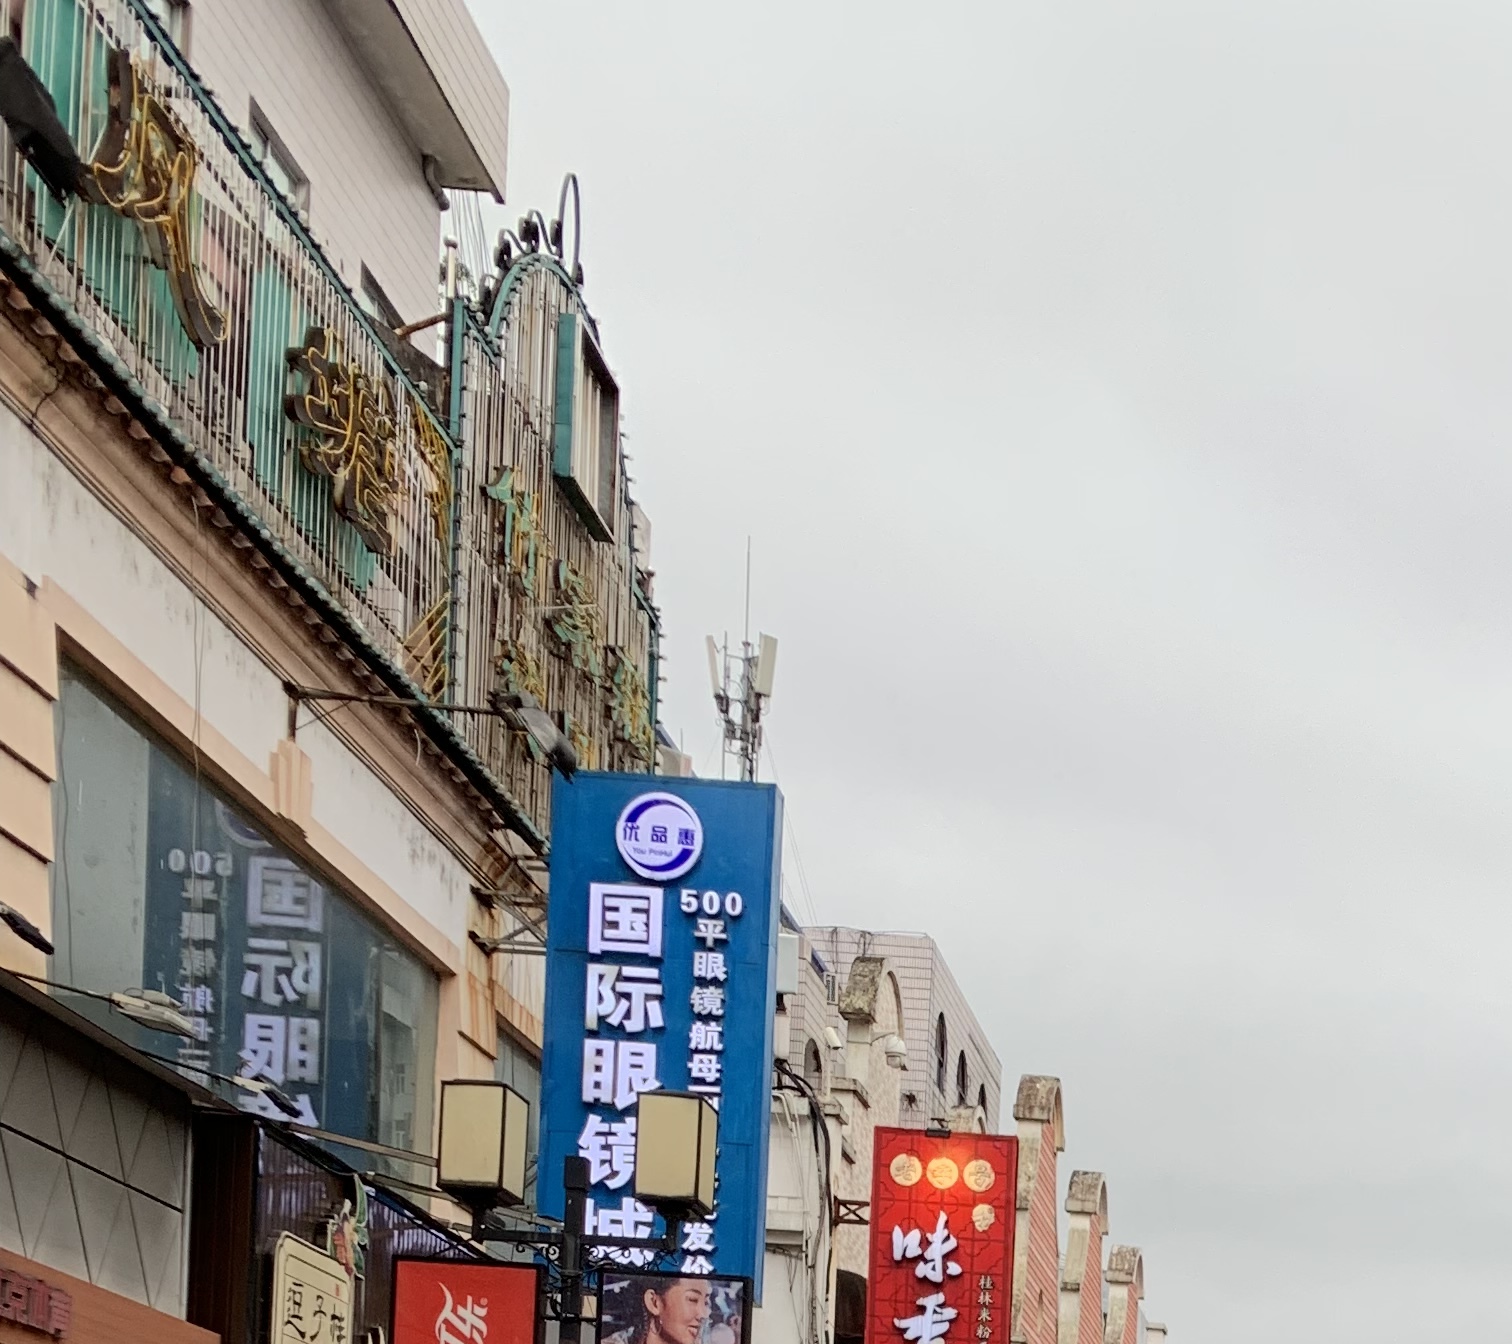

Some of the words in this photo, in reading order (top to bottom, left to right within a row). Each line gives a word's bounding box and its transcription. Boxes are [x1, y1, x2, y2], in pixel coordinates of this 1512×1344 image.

[623, 823, 695, 846] 优品惠
[680, 889, 743, 917] 500
